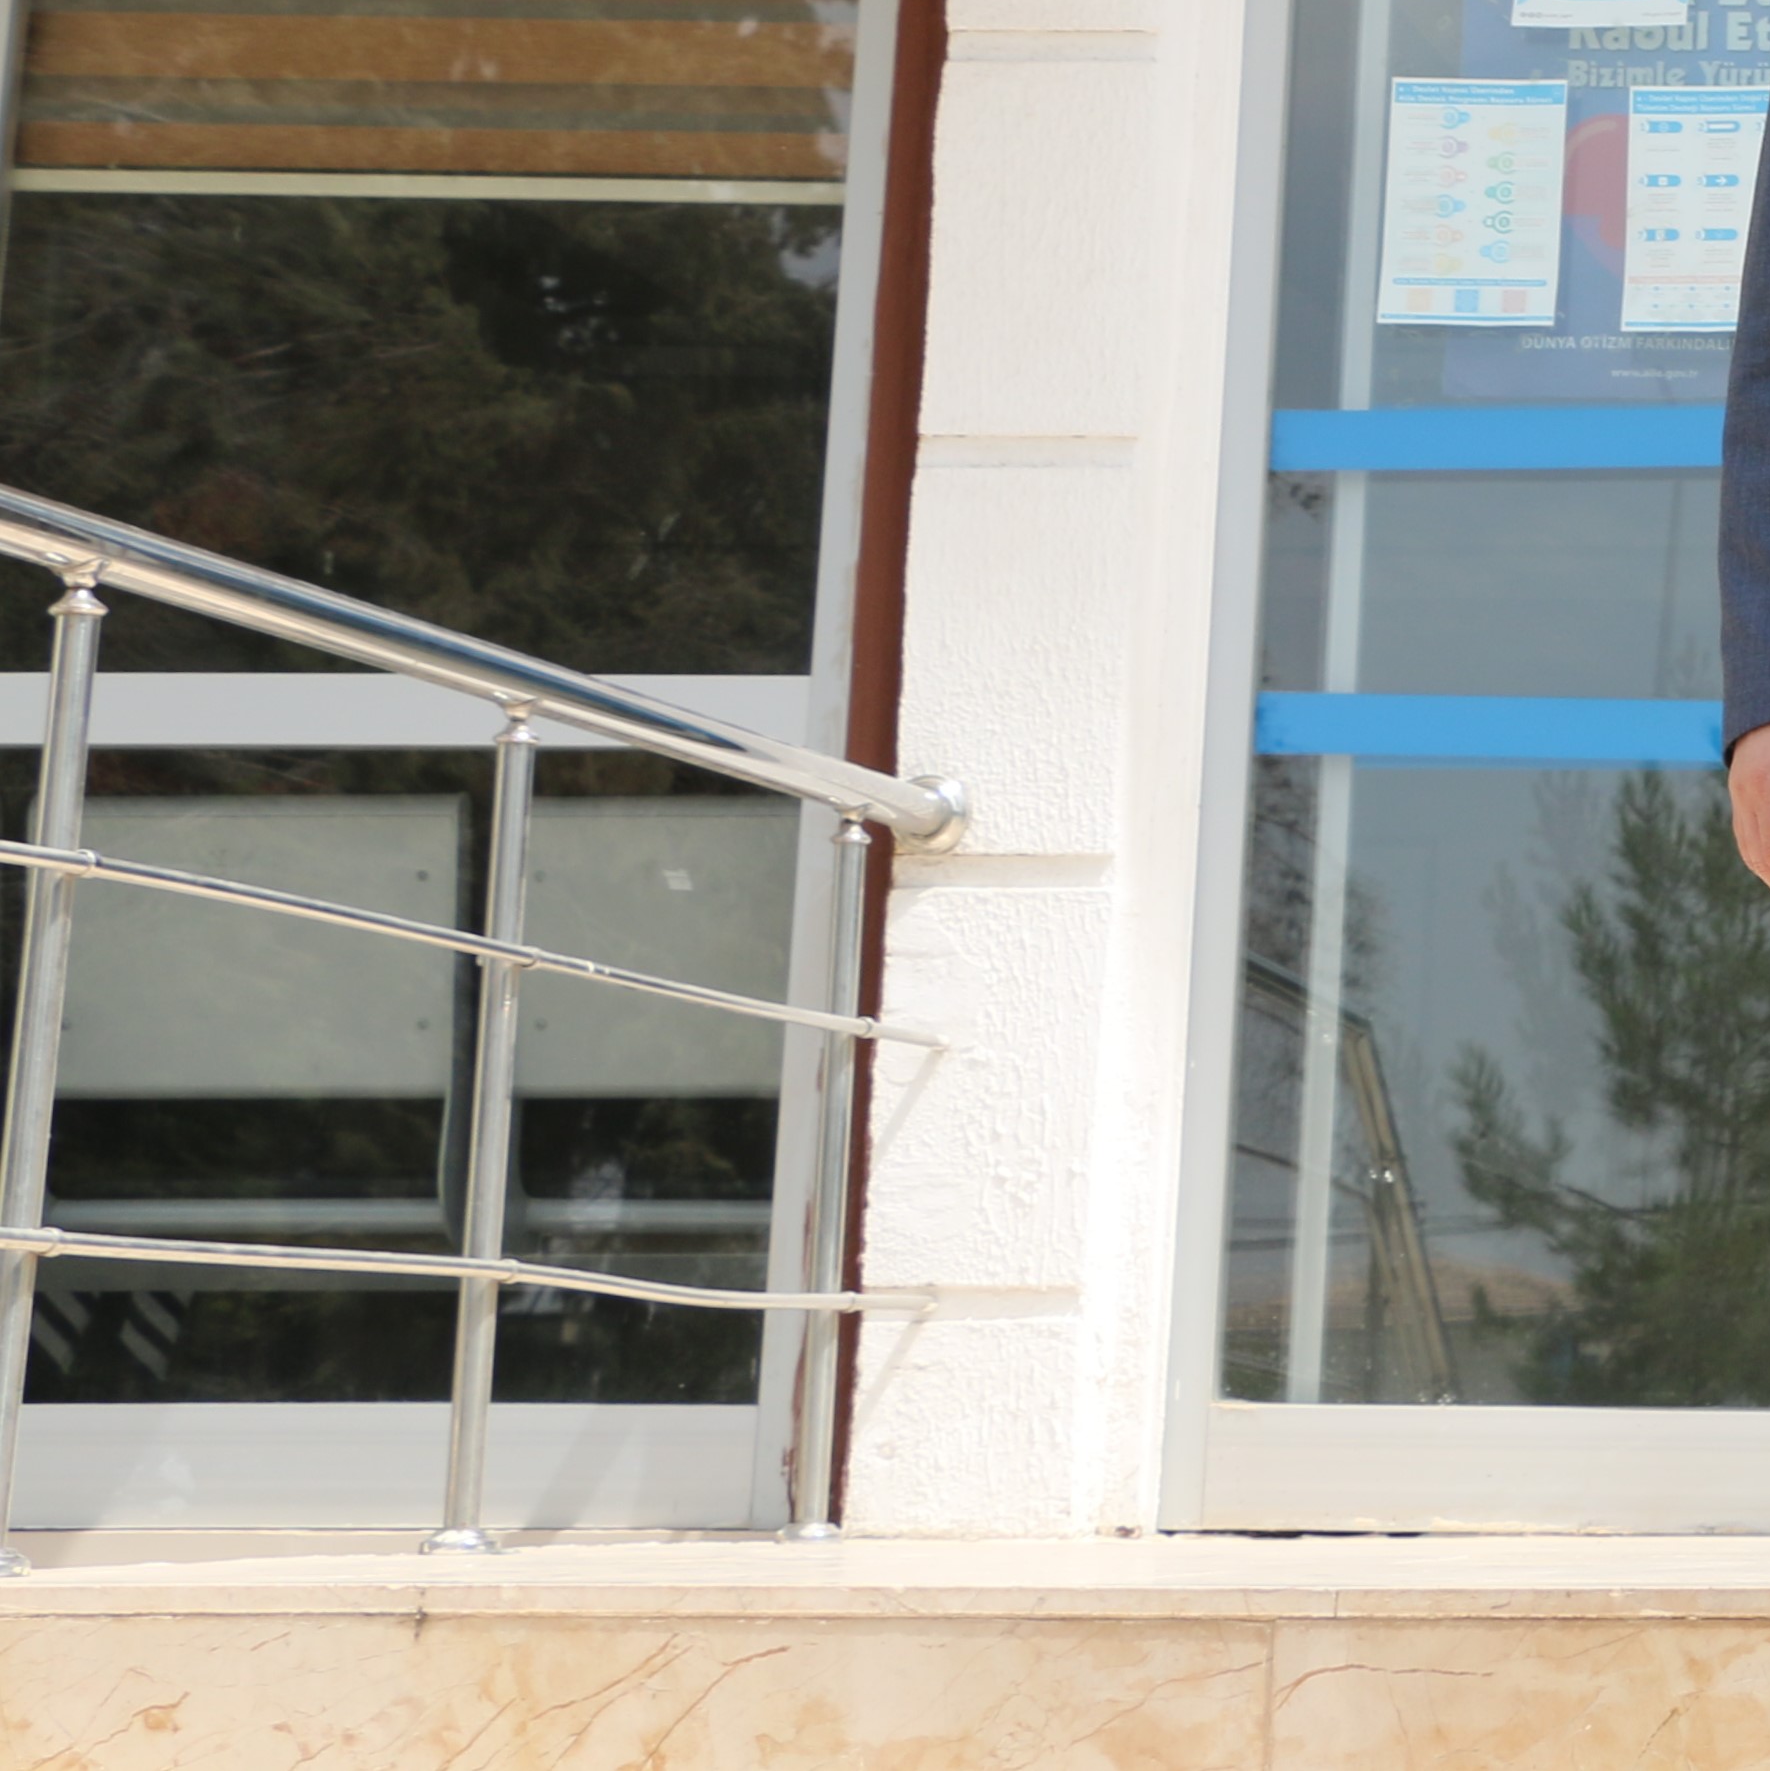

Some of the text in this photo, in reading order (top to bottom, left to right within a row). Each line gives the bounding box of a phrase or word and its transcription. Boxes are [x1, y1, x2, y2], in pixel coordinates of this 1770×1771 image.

[1567, 59, 1687, 88] Bizimle
[1521, 334, 1576, 350] DÜNYA
[1635, 336, 1736, 351] FARKINDALI
